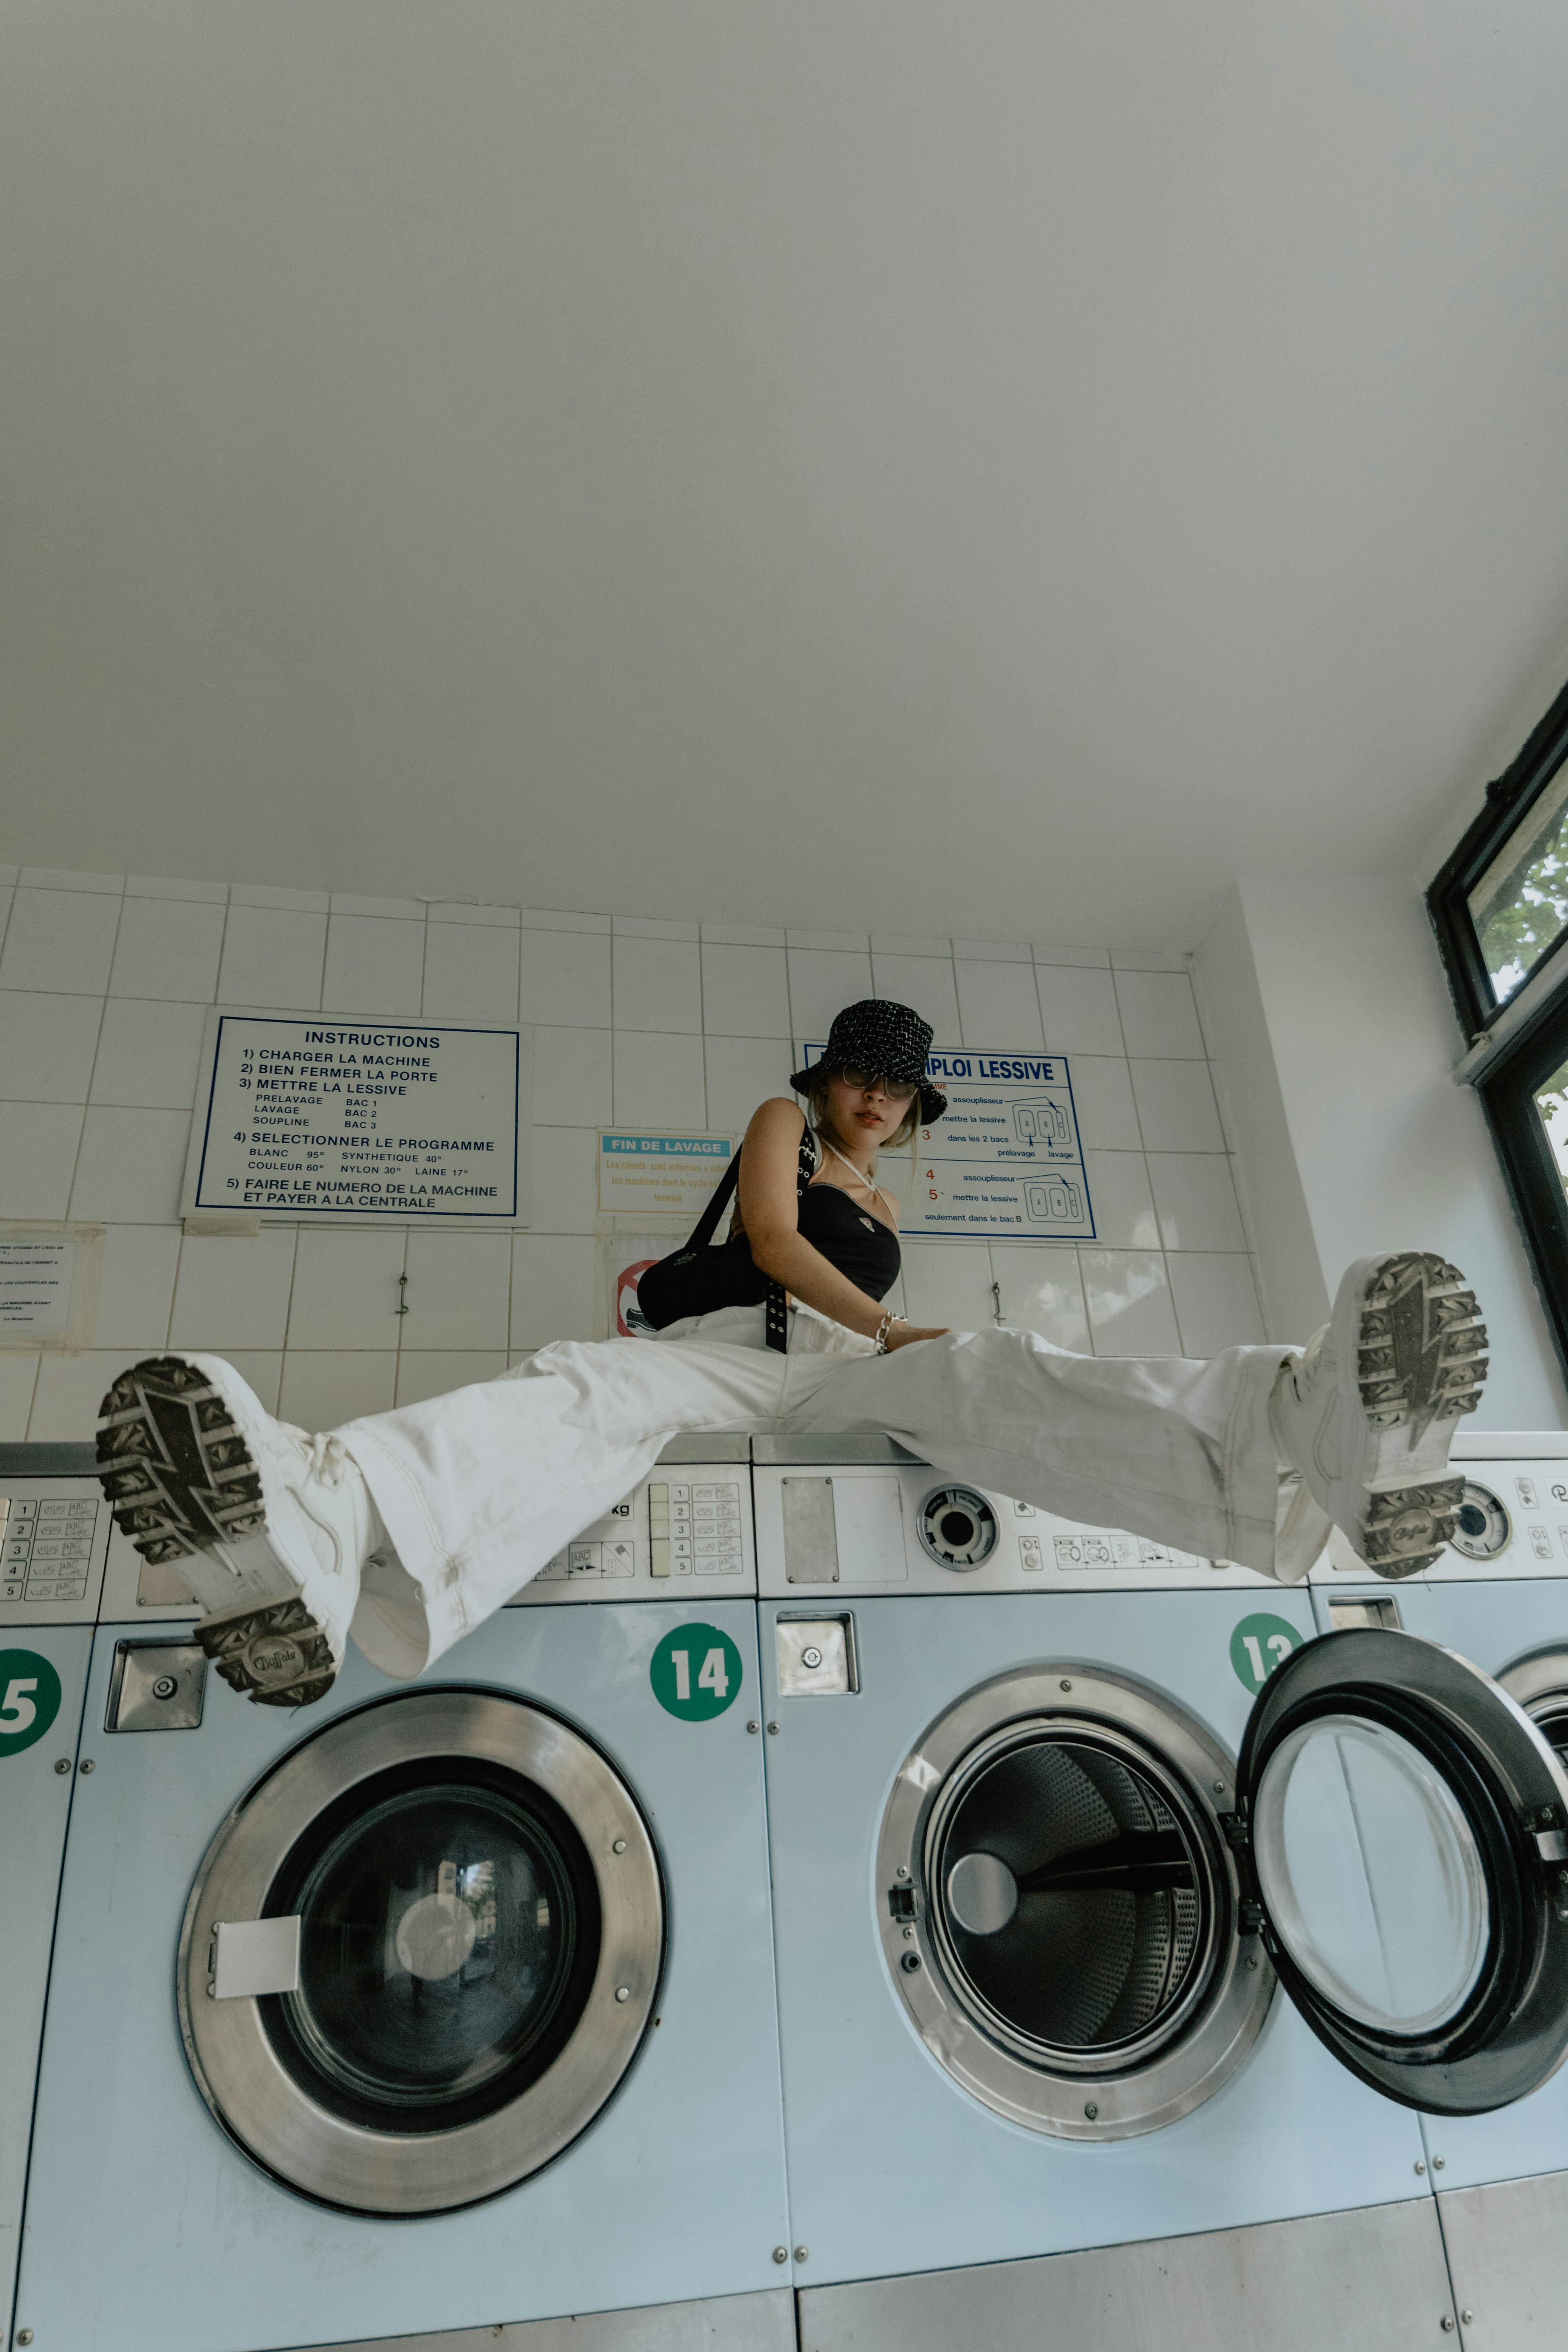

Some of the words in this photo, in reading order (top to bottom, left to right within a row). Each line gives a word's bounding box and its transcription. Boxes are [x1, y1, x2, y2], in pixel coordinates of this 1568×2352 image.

[306, 1031, 439, 1048] INSTRUCTIONS
[243, 1049, 254, 1060] 1)
[260, 1050, 332, 1062] CHARGER
[339, 1054, 356, 1063] LA
[363, 1055, 430, 1067] MACHINE
[241, 1063, 252, 1074] 2)
[259, 1065, 294, 1075] BIEN
[301, 1067, 361, 1078] FERMER
[368, 1070, 384, 1079] LA
[391, 1071, 437, 1082] PORTE
[979, 1060, 1054, 1080] LESSIVE
[240, 1078, 251, 1089] 3)
[257, 1079, 318, 1091] METTRE
[324, 1083, 341, 1092] LA
[348, 1084, 406, 1095] LESSIVE
[256, 1094, 322, 1104] PRELAVAGE
[953, 1096, 1003, 1105] assouplisseur
[255, 1105, 299, 1114] LAVAGE
[253, 1117, 309, 1126] SOUPLINE
[922, 1130, 930, 1140] 3
[234, 1132, 245, 1143] 4)
[252, 1133, 369, 1146] SELECTIONNER
[376, 1138, 393, 1147] LE
[399, 1139, 494, 1151] PROGRAMME
[612, 1140, 636, 1150] FIN
[641, 1141, 661, 1151] DE
[665, 1142, 721, 1153] LAVAGE
[250, 1149, 288, 1157] BLANC
[342, 1152, 418, 1161] SYNTHETIQUE
[249, 1162, 302, 1170] COULEUR
[607, 1160, 619, 1169] Les
[621, 1161, 646, 1170] clients
[926, 1169, 935, 1179] 4
[963, 1174, 1015, 1184] assouplisseur
[227, 1178, 239, 1190] 5)
[246, 1179, 289, 1189] FAIRE
[294, 1181, 311, 1190] LE
[316, 1181, 381, 1192] NUMERO
[387, 1184, 405, 1193] DE
[410, 1185, 427, 1194] LA
[432, 1185, 497, 1196] MACHINE
[689, 1180, 707, 1189] cycle
[244, 1192, 263, 1202] ET
[267, 1193, 317, 1203] PAYER
[321, 1195, 331, 1204] A
[336, 1196, 354, 1205] LA
[359, 1196, 435, 1207] CENTRALE
[929, 1189, 937, 1200] 5
[14, 1546, 20, 1554] 3
[573, 1552, 588, 1562] ABC
[254, 1651, 296, 1671] Buffalo
[671, 1648, 729, 1699] 14
